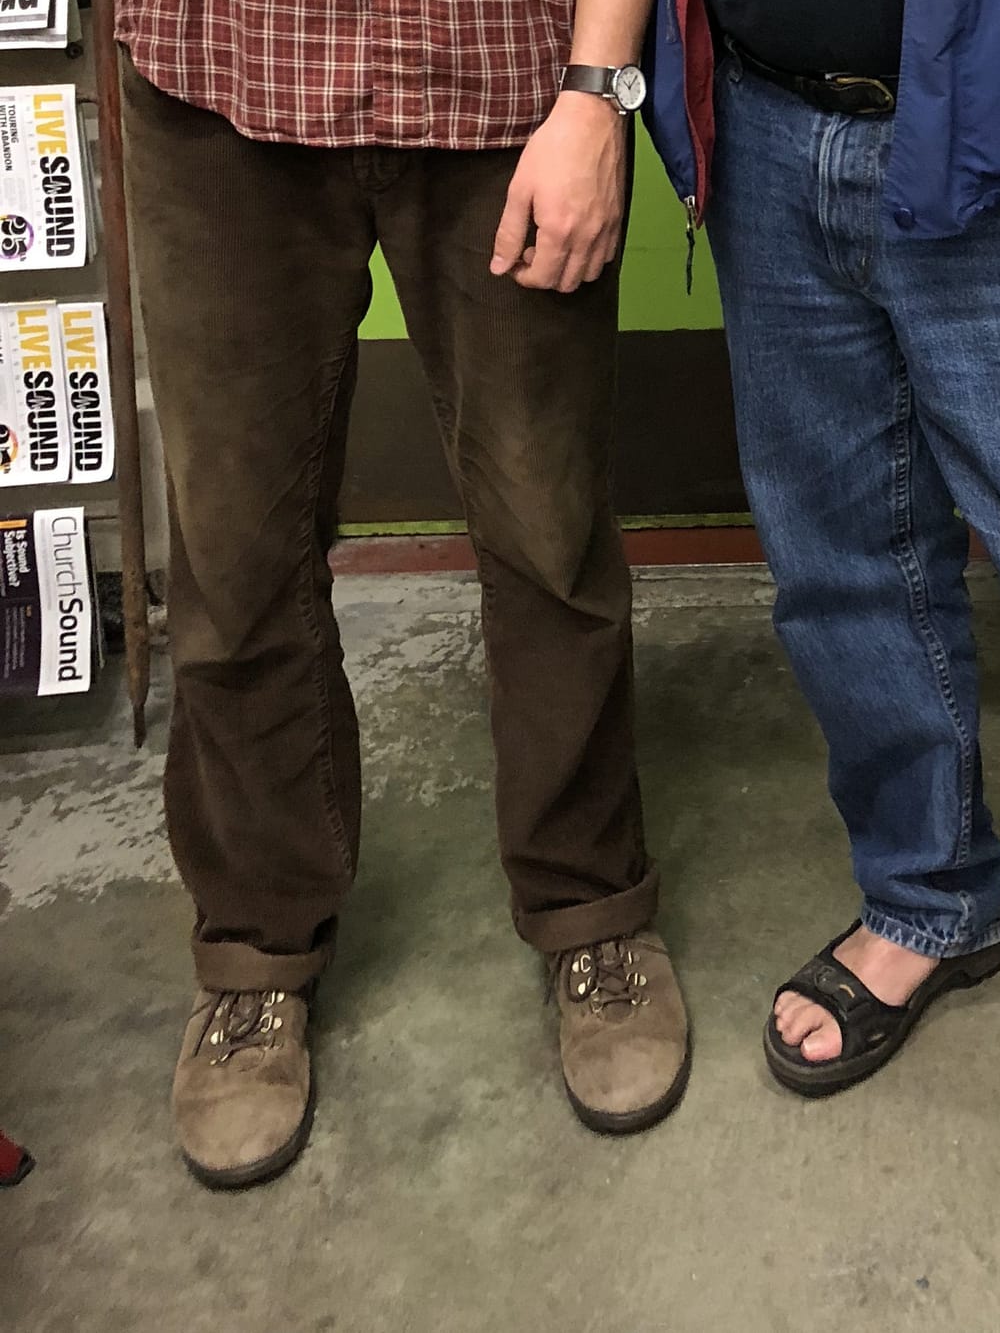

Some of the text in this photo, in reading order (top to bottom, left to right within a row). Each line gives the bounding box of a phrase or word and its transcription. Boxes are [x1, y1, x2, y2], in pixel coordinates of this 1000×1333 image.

[8, 104, 19, 144] TOURING
[1, 129, 13, 171] ABANDON
[4, 530, 21, 588] Subjective?
[15, 529, 31, 574] Is Sound
